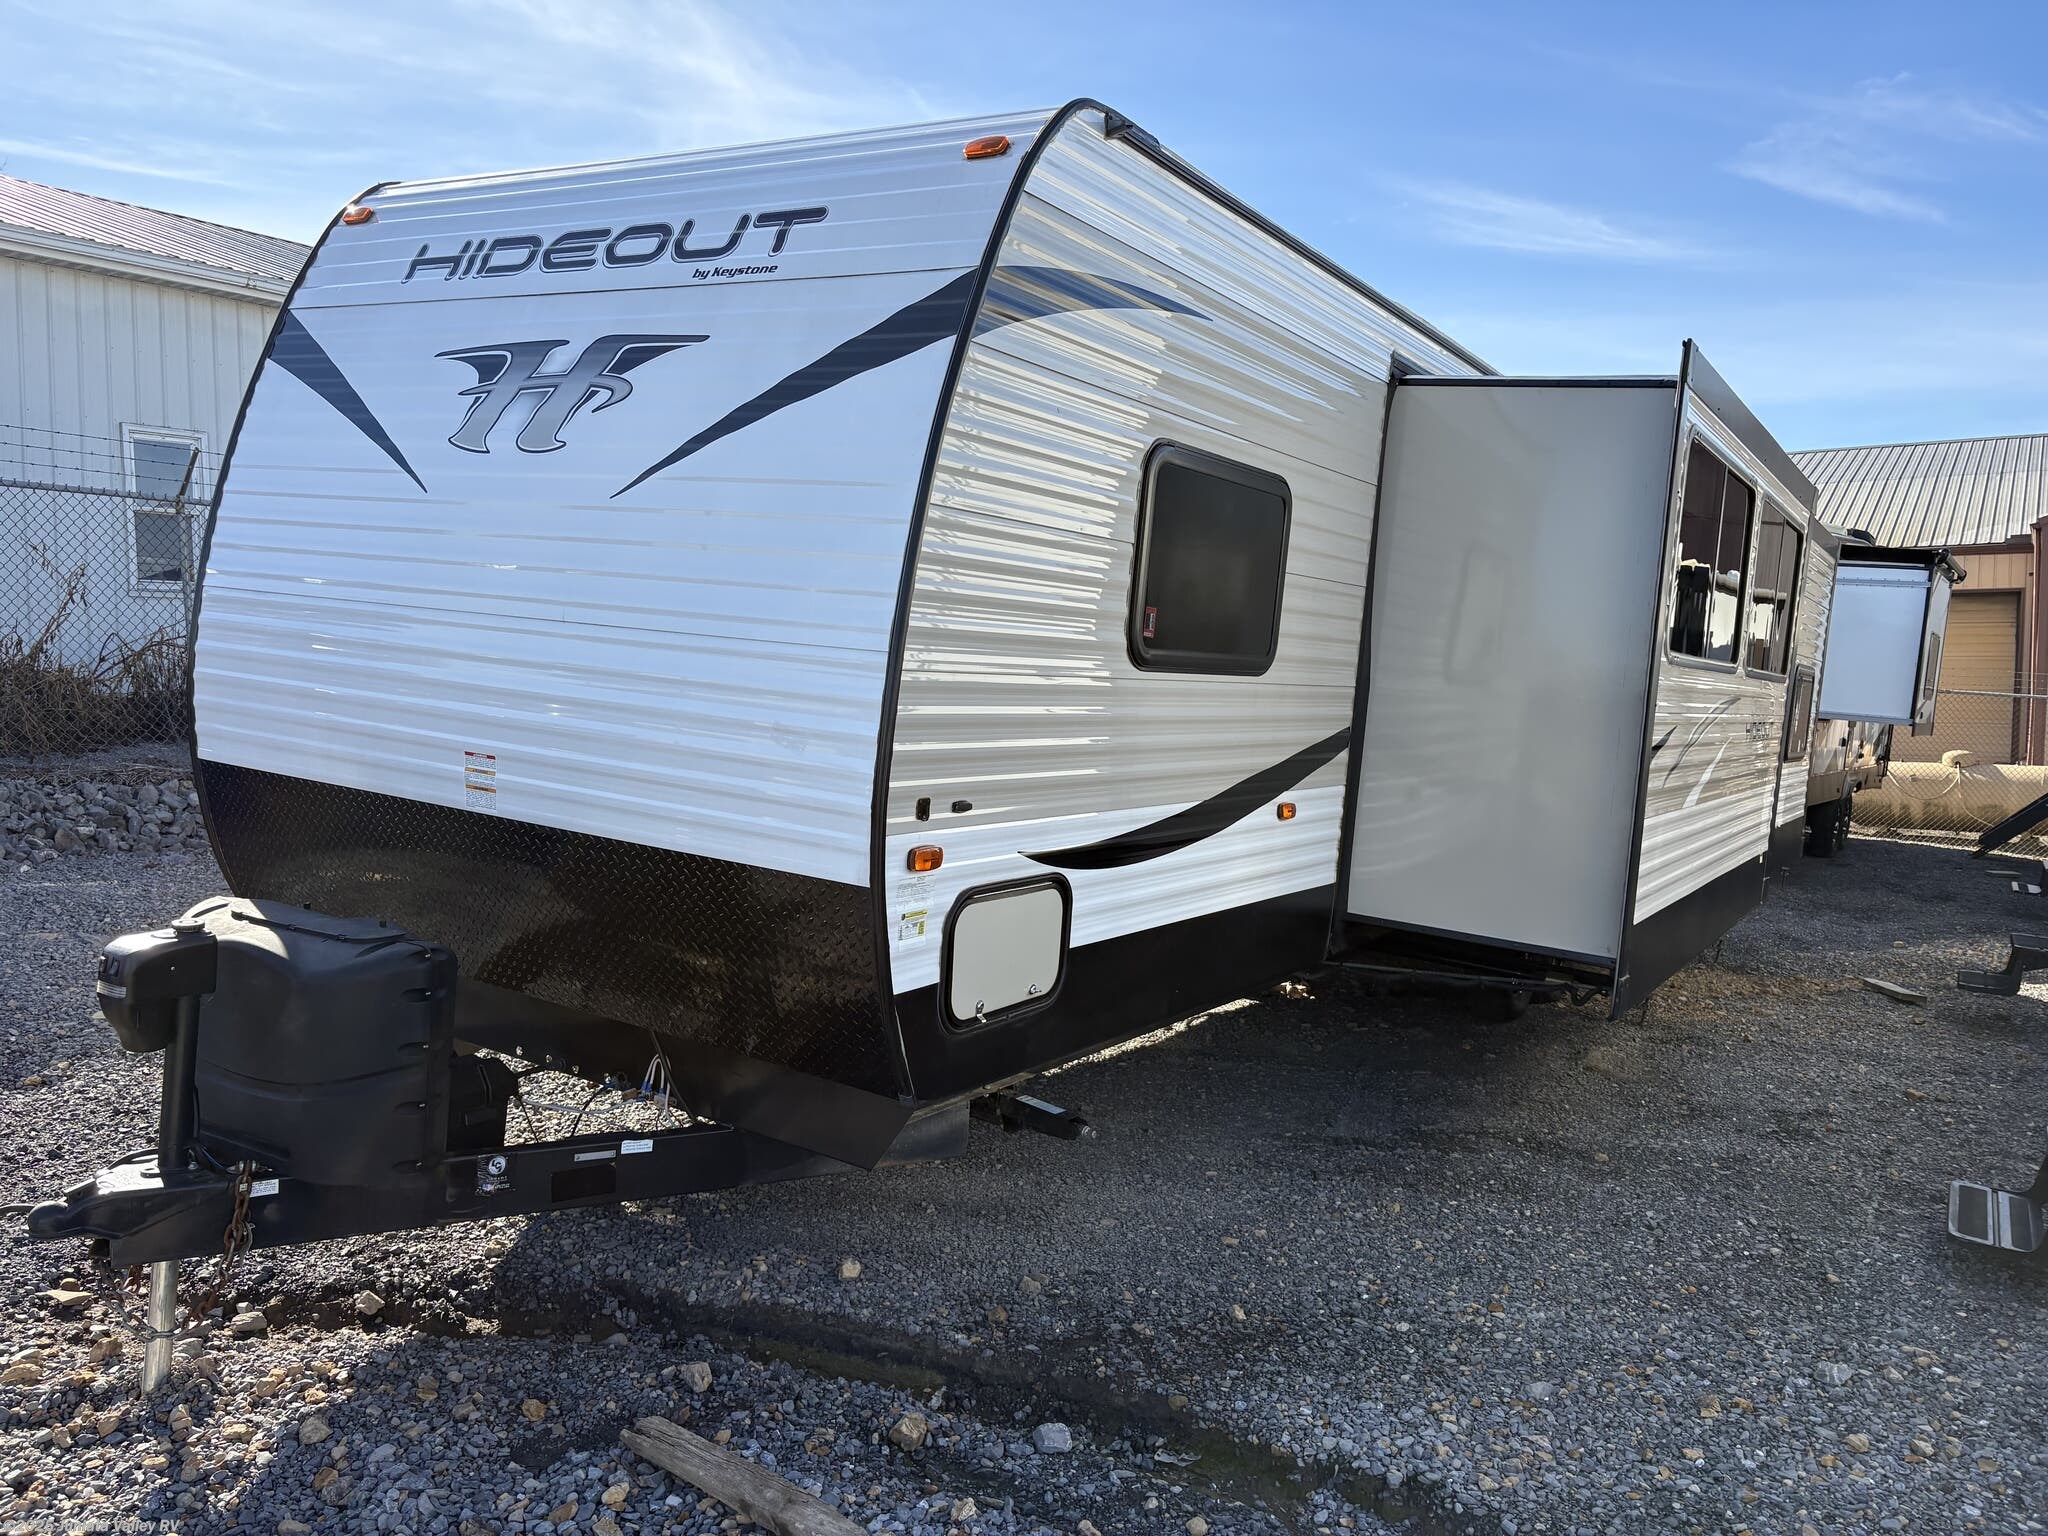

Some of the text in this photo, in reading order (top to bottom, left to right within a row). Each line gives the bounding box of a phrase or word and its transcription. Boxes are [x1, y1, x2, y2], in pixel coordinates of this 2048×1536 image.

[401, 206, 829, 284] HIDEOUT
[692, 265, 779, 280] by Keystone
